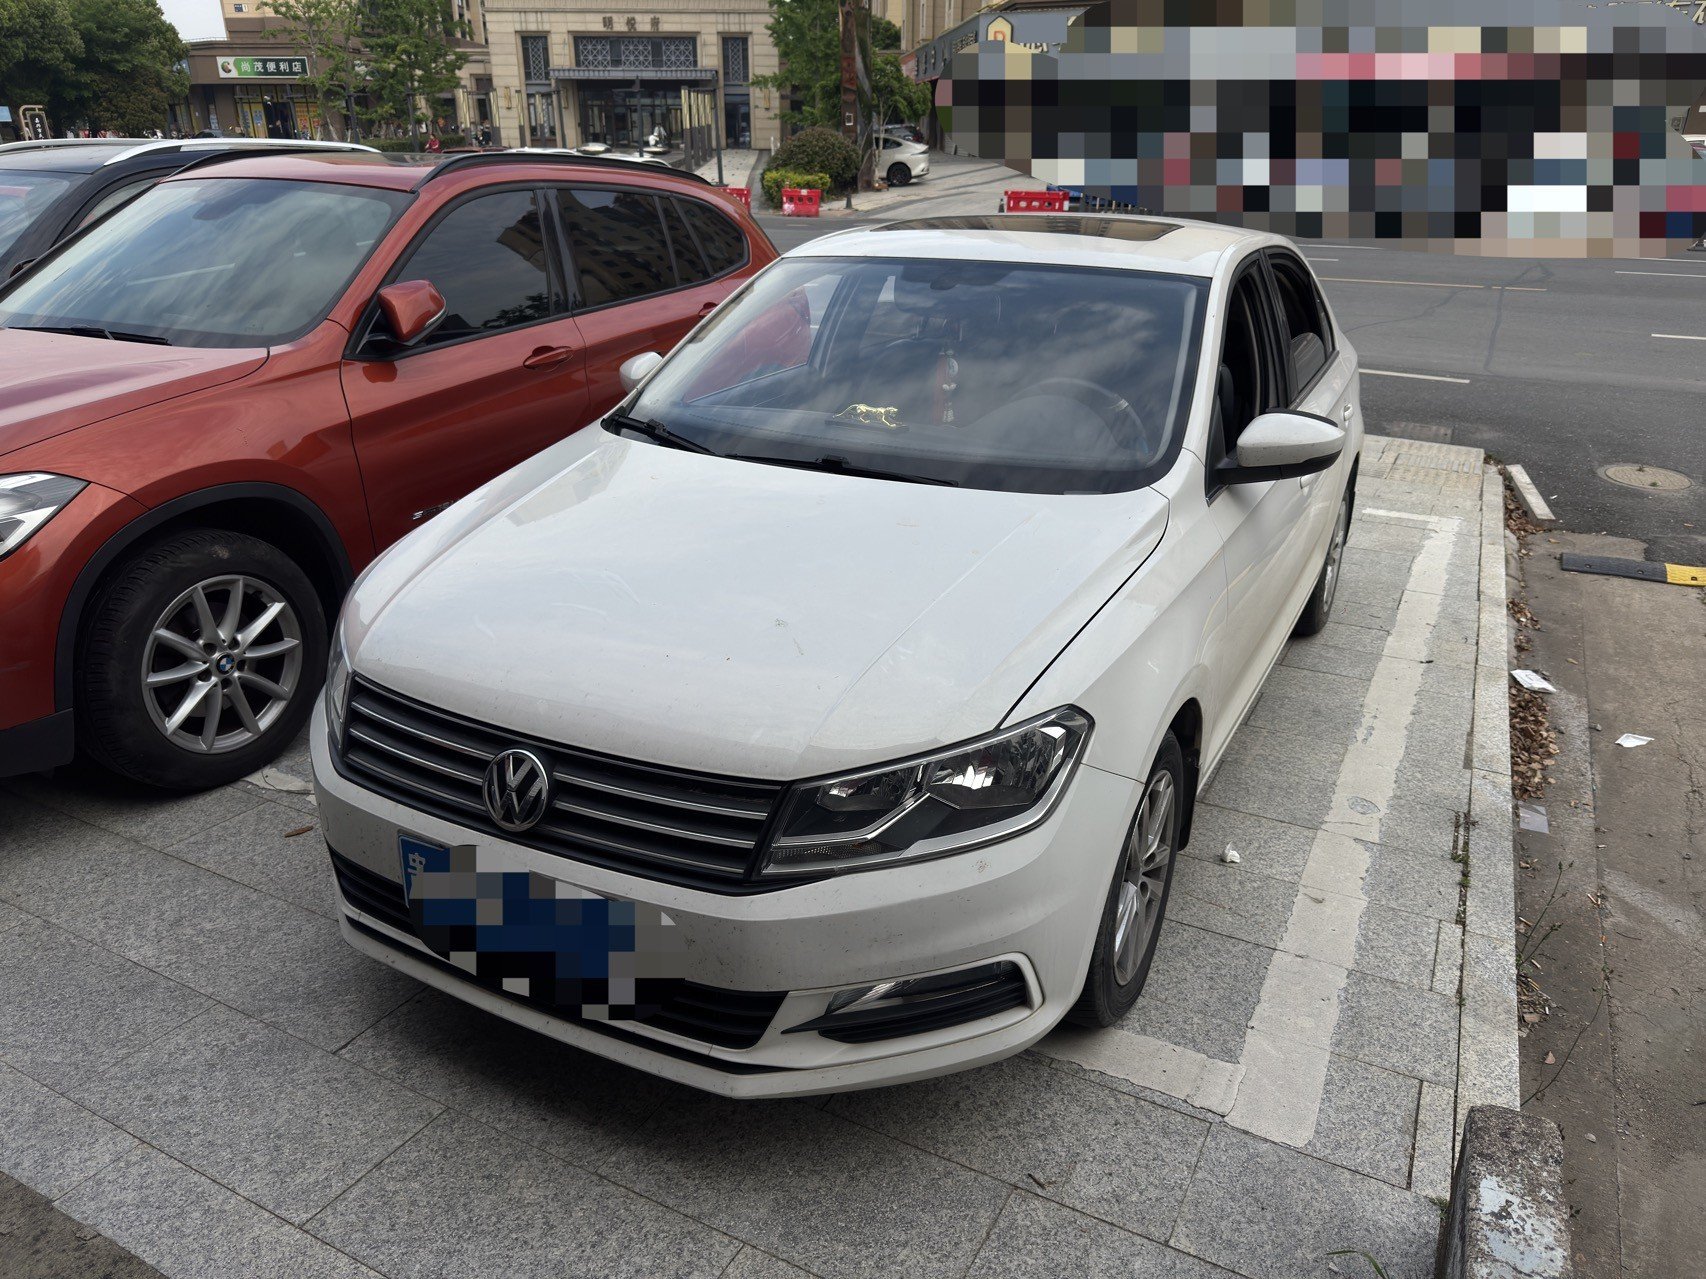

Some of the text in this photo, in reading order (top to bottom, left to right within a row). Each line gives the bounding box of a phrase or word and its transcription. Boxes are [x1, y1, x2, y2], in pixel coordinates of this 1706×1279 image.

[240, 61, 302, 73] 尚茂便利店
